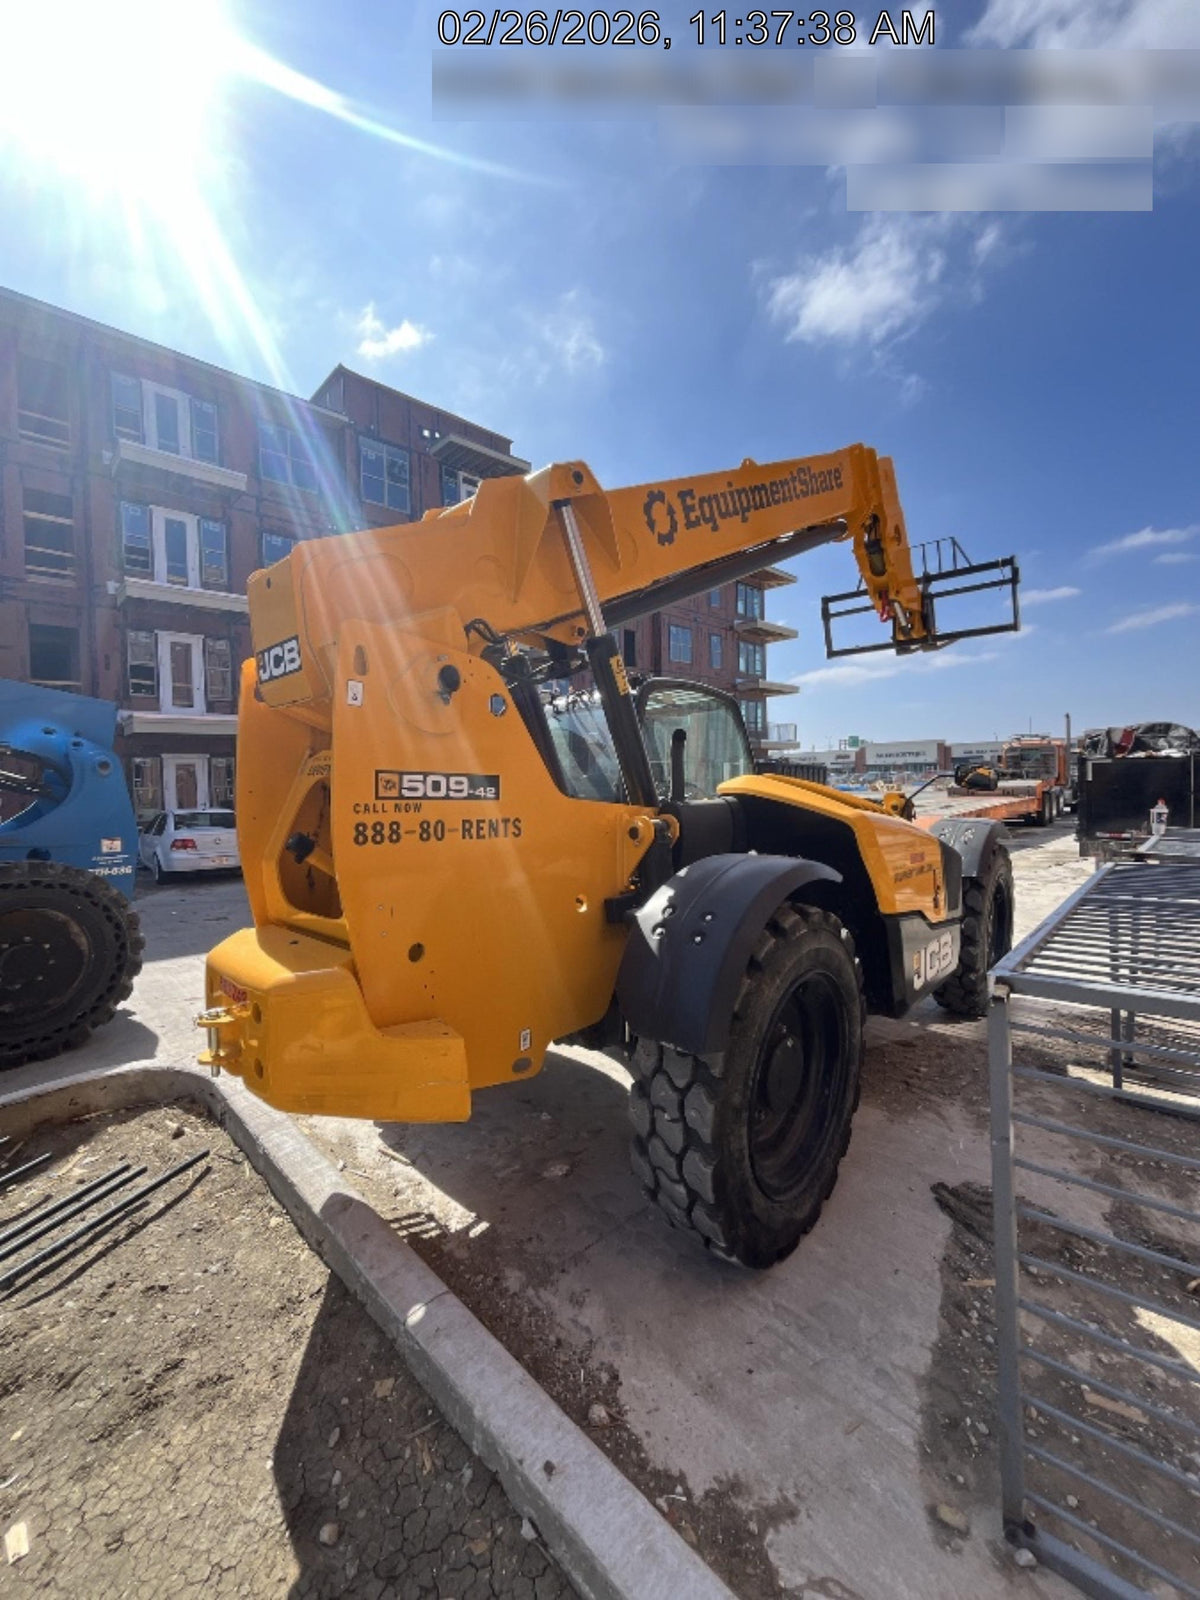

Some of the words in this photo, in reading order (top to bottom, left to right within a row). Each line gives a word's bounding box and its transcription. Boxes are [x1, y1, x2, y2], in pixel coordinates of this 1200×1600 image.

[677, 466, 843, 532] EquipmentShare
[259, 639, 300, 680] JCB
[353, 803, 388, 814] CALL
[394, 802, 422, 813] NOW
[353, 818, 522, 846] 888-80-RENTS
[913, 931, 953, 990] JCB
